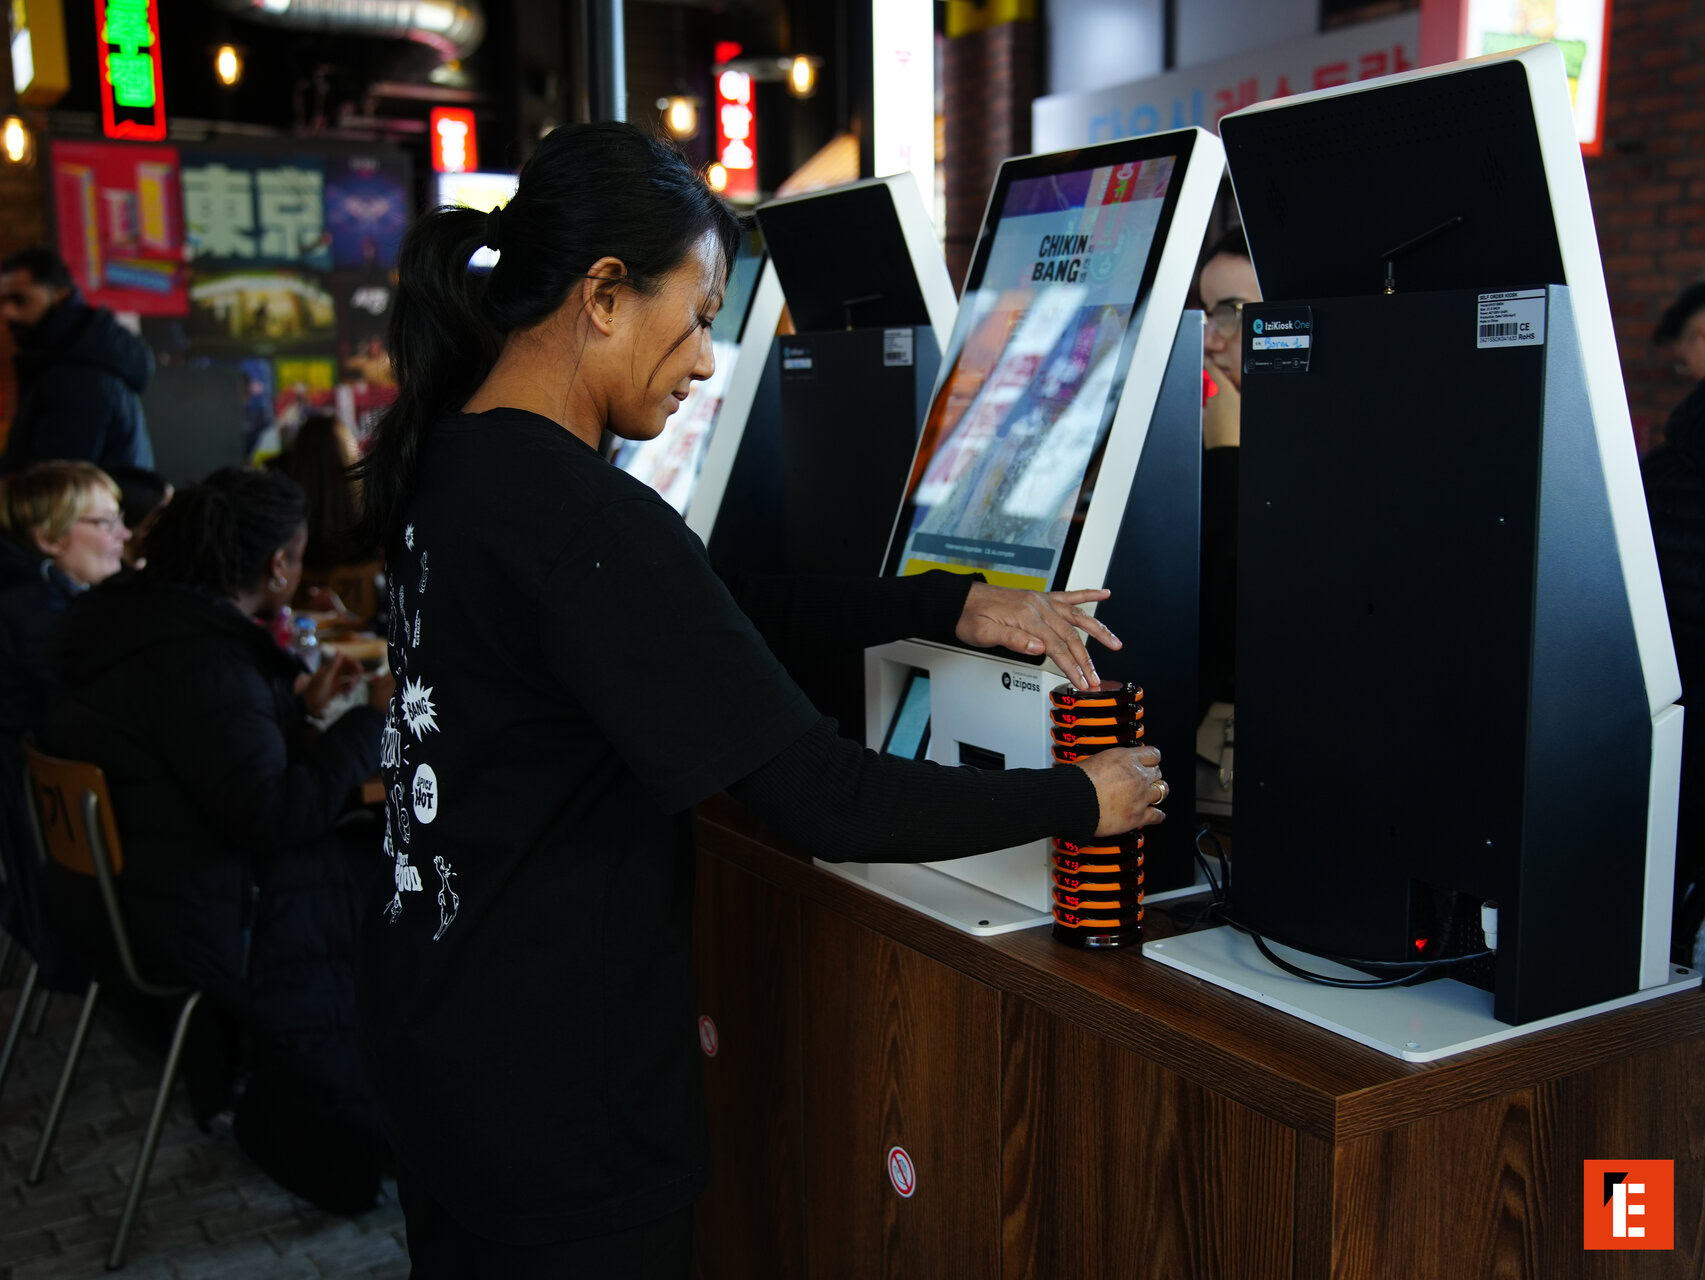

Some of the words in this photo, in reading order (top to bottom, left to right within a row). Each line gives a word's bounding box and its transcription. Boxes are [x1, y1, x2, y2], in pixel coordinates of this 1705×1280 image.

[1038, 234, 1089, 258] CHIKIN
[1031, 258, 1081, 283] BANG
[1265, 320, 1294, 331] IziKiosk
[1294, 319, 1310, 330] One
[1520, 322, 1530, 331] CE
[1012, 675, 1041, 693] izipass
[1062, 695, 1076, 705] 454
[406, 697, 428, 721] BANG
[1062, 713, 1077, 724] 469
[1062, 732, 1076, 742] 404
[1063, 750, 1077, 761] 470
[416, 776, 433, 789] SPICY
[415, 788, 433, 810] HOT
[1064, 859, 1079, 870] 413
[1064, 877, 1080, 889] 412
